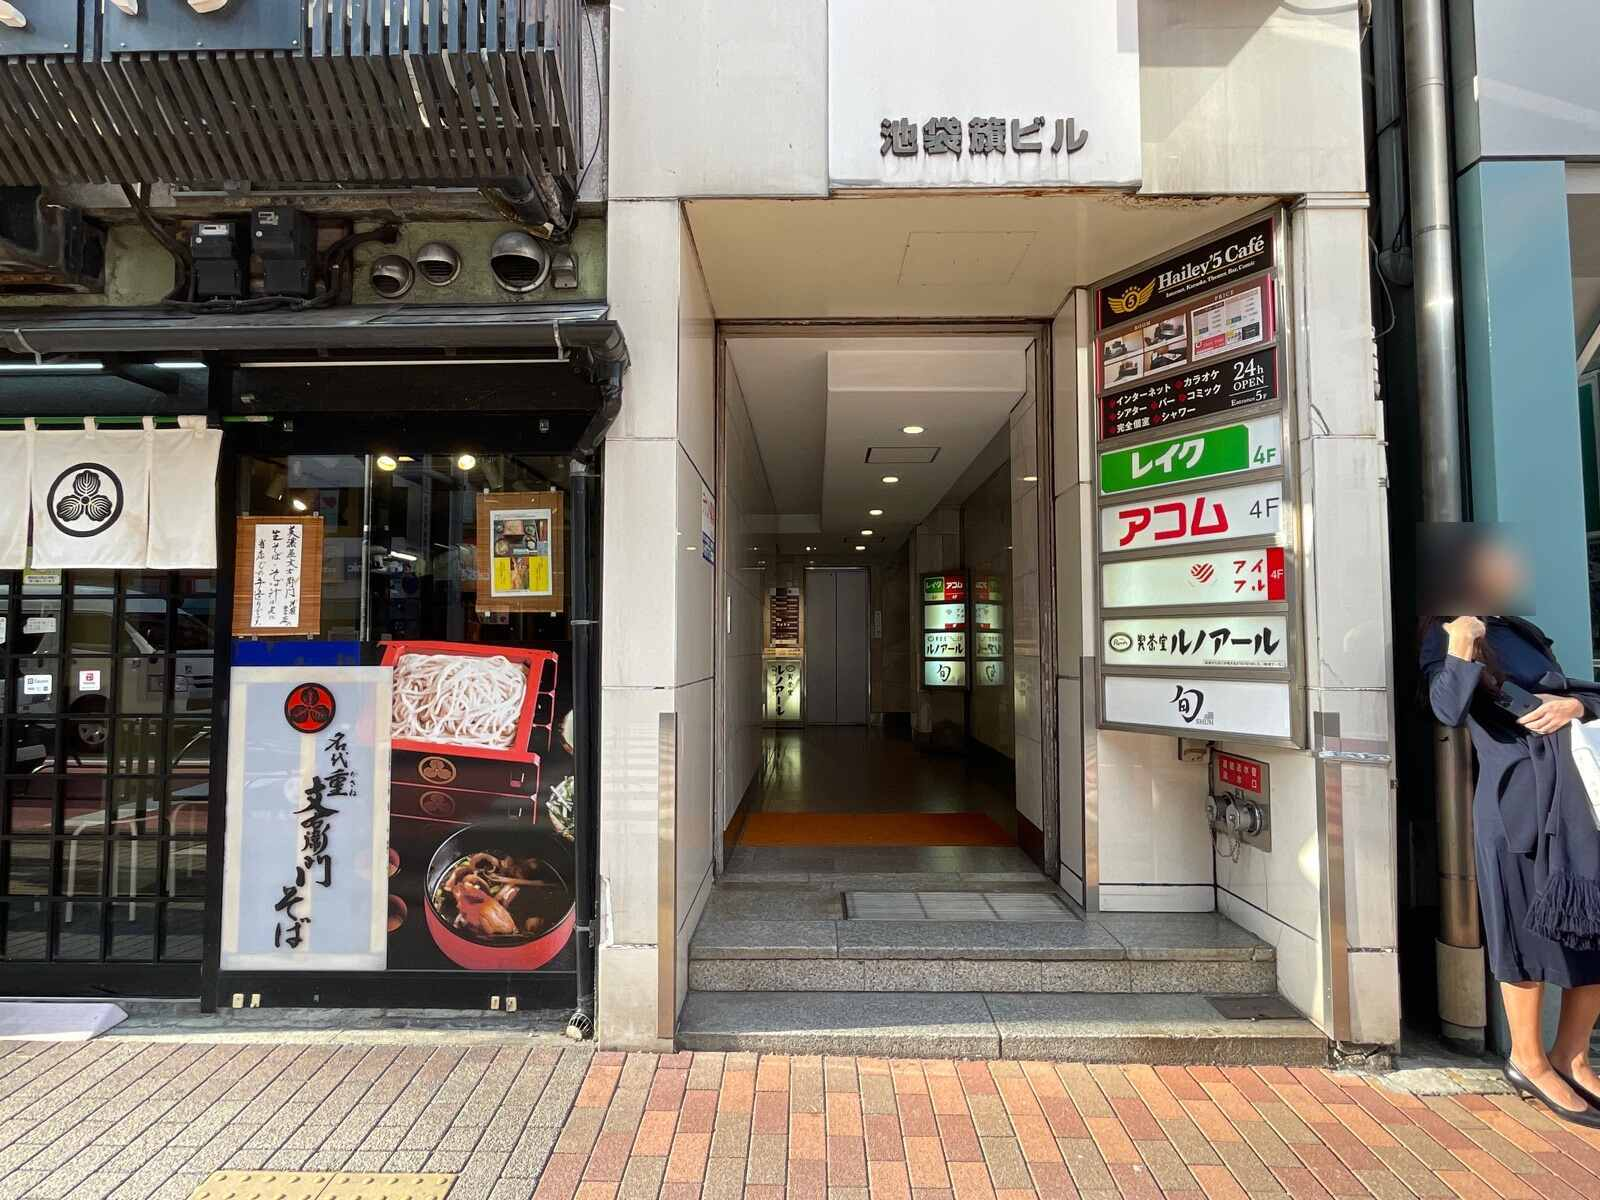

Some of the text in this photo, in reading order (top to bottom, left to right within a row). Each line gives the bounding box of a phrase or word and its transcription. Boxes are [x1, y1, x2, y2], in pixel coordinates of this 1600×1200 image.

[1225, 234, 1264, 263] Café
[1184, 369, 1220, 387] カラオケ
[1233, 358, 1264, 381] 24h
[1187, 384, 1221, 400] コミック
[1233, 375, 1264, 391] OPEN
[1116, 383, 1171, 405] インターネット
[1159, 398, 1175, 408] バー
[1117, 405, 1147, 419] シアター
[1161, 407, 1196, 422] シャワー
[1116, 417, 1150, 433] 完全個室
[1131, 437, 1276, 480] レイク 4F
[1119, 496, 1280, 547] アコム 4F
[1270, 568, 1284, 579] 4F
[946, 581, 963, 589] アコム
[927, 643, 965, 654] ルノアール
[1170, 627, 1280, 656] ルノアール
[937, 664, 951, 682] 旬
[776, 665, 785, 715] ルノアール
[1169, 685, 1204, 723] 旬
[275, 886, 311, 949] そば
